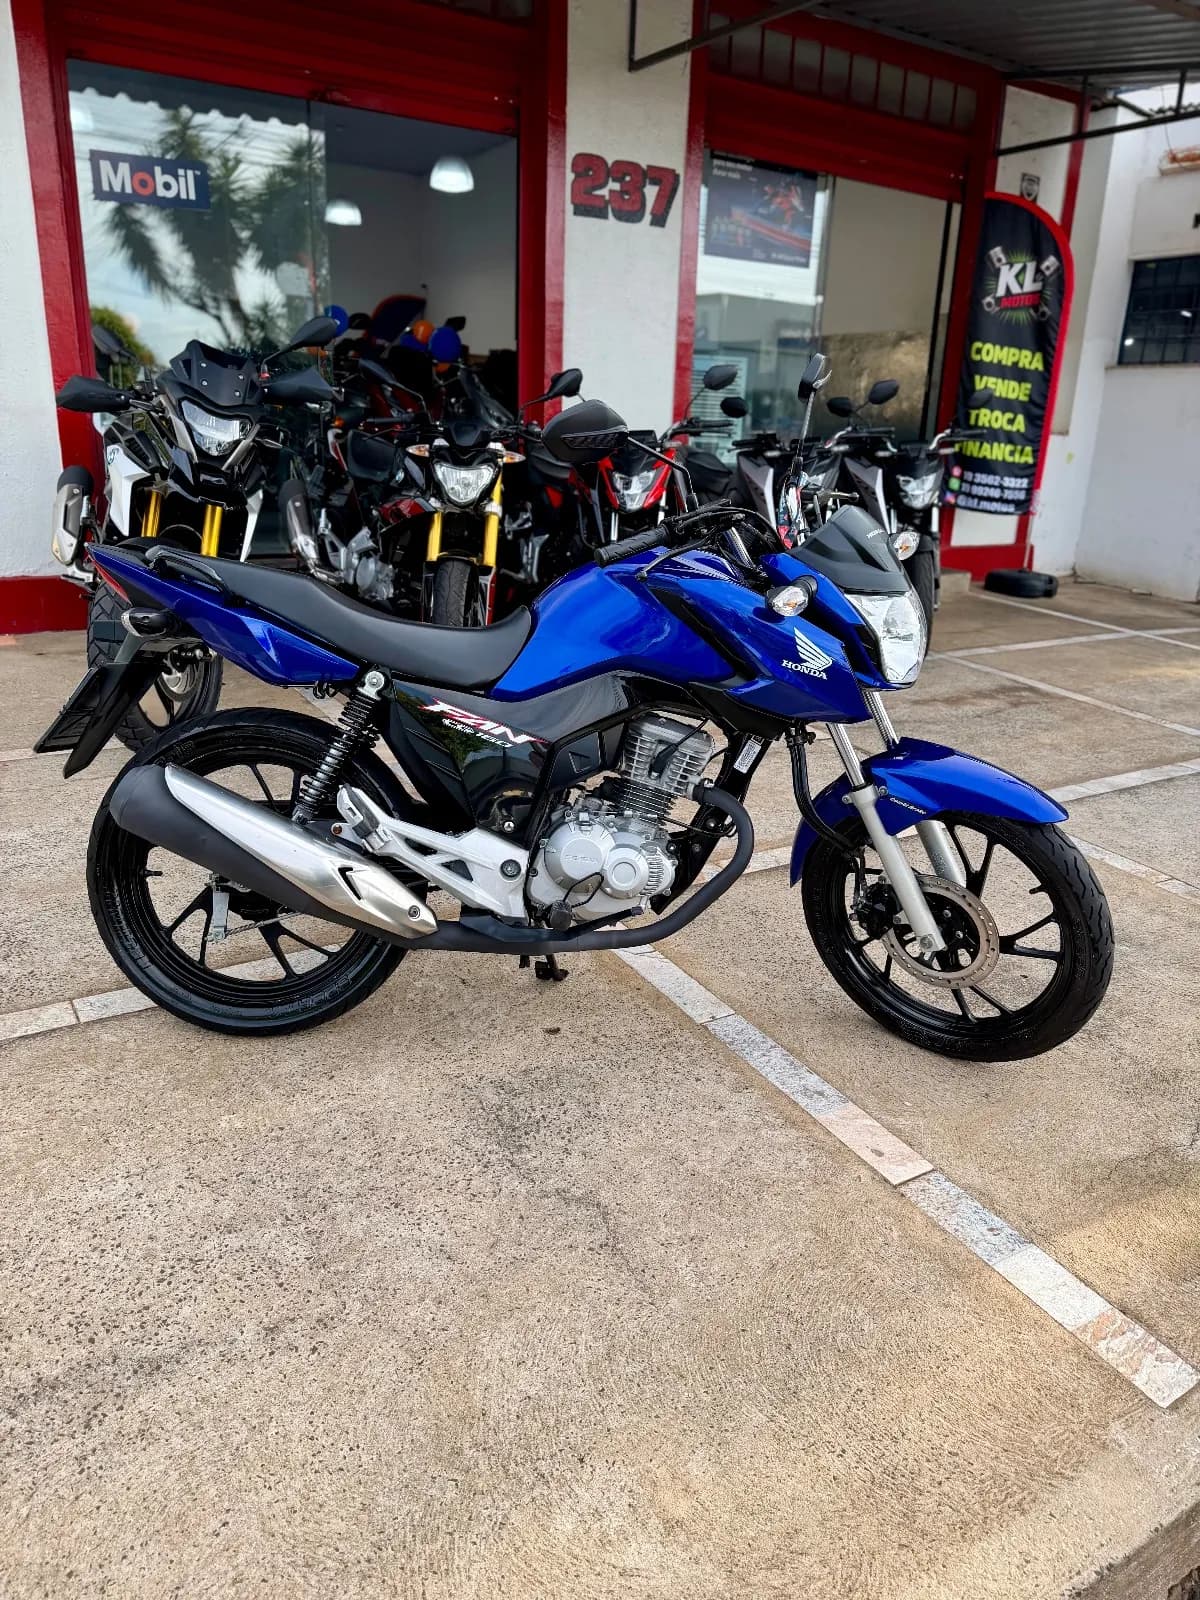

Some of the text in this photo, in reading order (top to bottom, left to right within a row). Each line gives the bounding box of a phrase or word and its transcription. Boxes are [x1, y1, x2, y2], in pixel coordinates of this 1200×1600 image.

[98, 159, 197, 201] Mobil
[571, 152, 680, 229] 237
[996, 261, 1043, 297] KL
[970, 341, 1044, 371] COMPRA
[968, 408, 1026, 433] TROCA
[781, 659, 828, 681] HONDA
